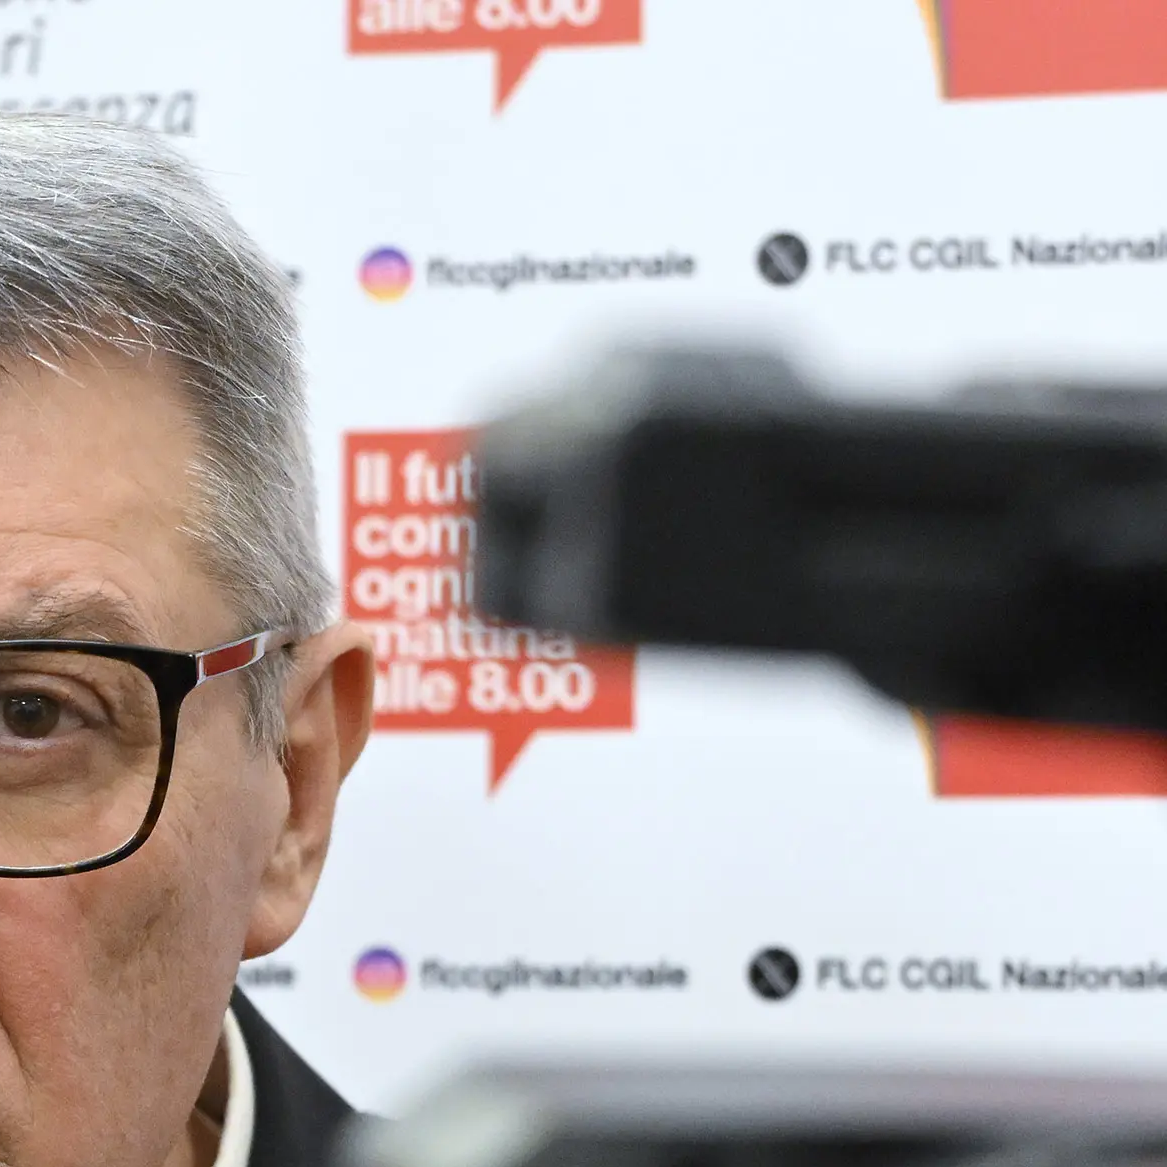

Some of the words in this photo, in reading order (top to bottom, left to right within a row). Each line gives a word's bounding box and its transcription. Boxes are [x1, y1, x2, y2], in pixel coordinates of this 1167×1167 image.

[825, 236, 897, 273] FLC
[908, 235, 998, 272] CGIL
[1011, 228, 1167, 267] Nazional
[354, 451, 391, 505] Il
[402, 449, 477, 505] fut
[352, 513, 478, 558] com
[352, 558, 476, 618] ogni
[467, 660, 596, 713] 8.00
[816, 956, 888, 991] FLC
[899, 955, 989, 992] CGIL
